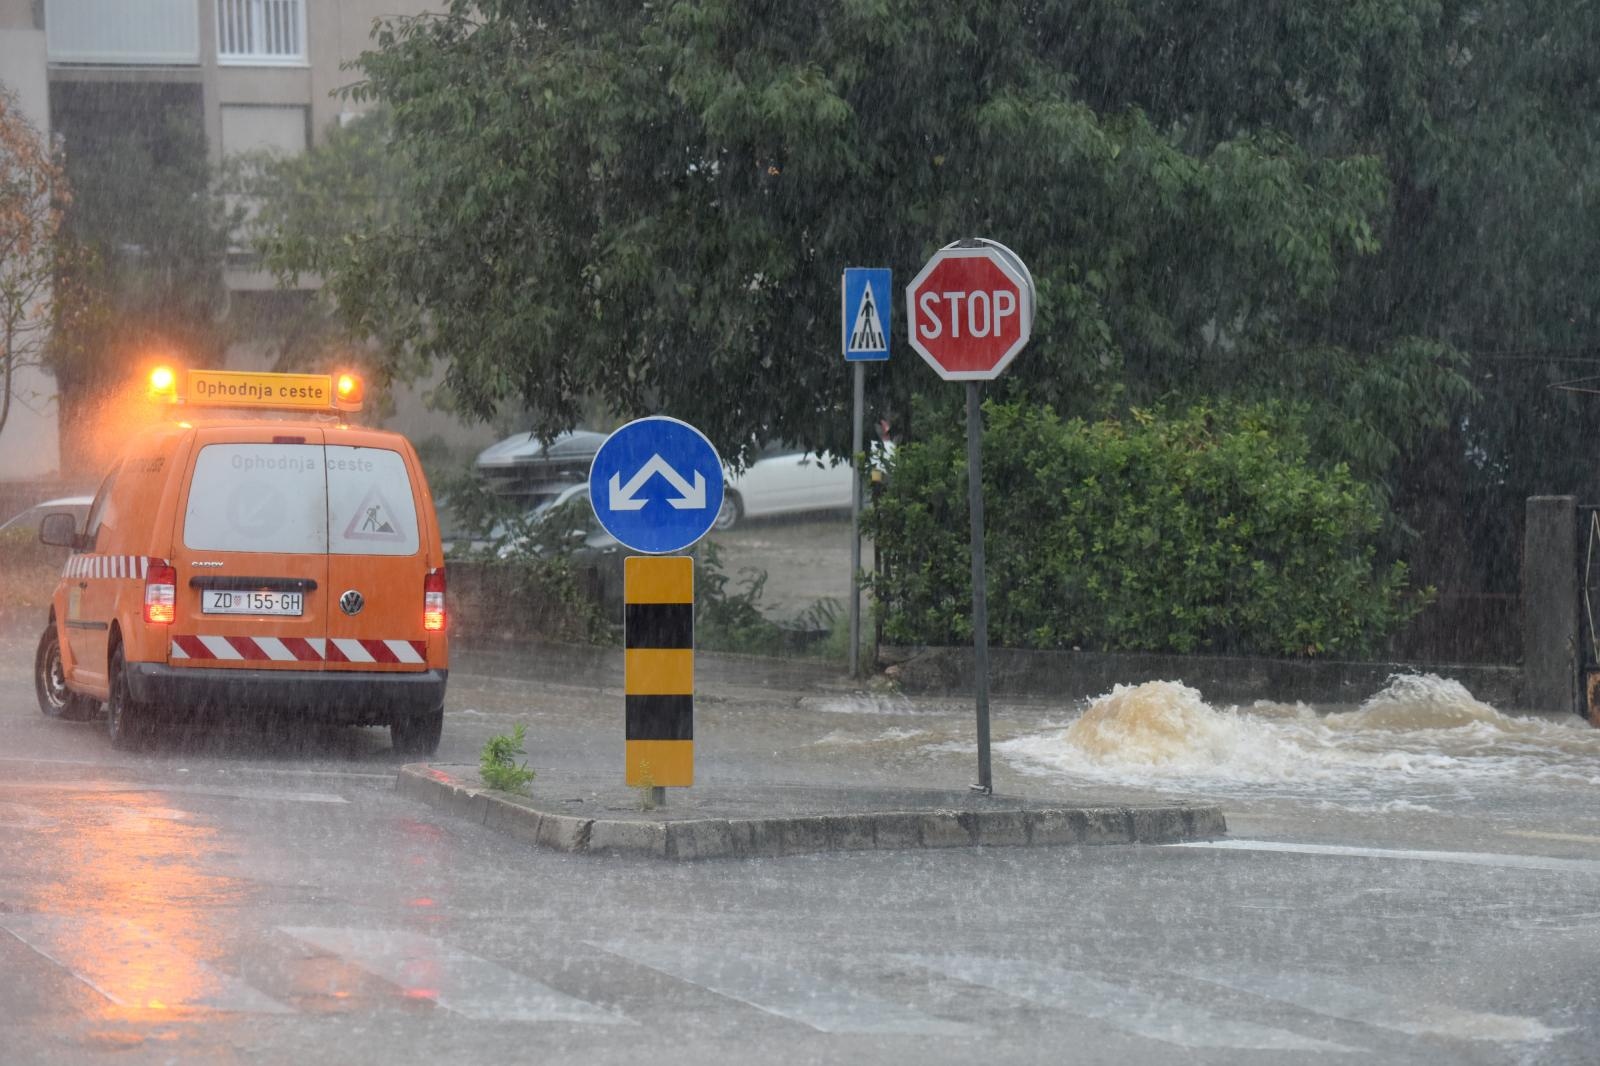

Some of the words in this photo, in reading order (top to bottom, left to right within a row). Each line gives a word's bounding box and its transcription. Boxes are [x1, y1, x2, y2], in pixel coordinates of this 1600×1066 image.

[920, 290, 1016, 339] STOP
[197, 380, 273, 399] Ophodnja
[280, 385, 323, 398] ceste
[231, 454, 316, 473] Ophodnja
[327, 457, 374, 472] ceste
[214, 593, 232, 608] ZD
[247, 594, 300, 610] 155-GH
